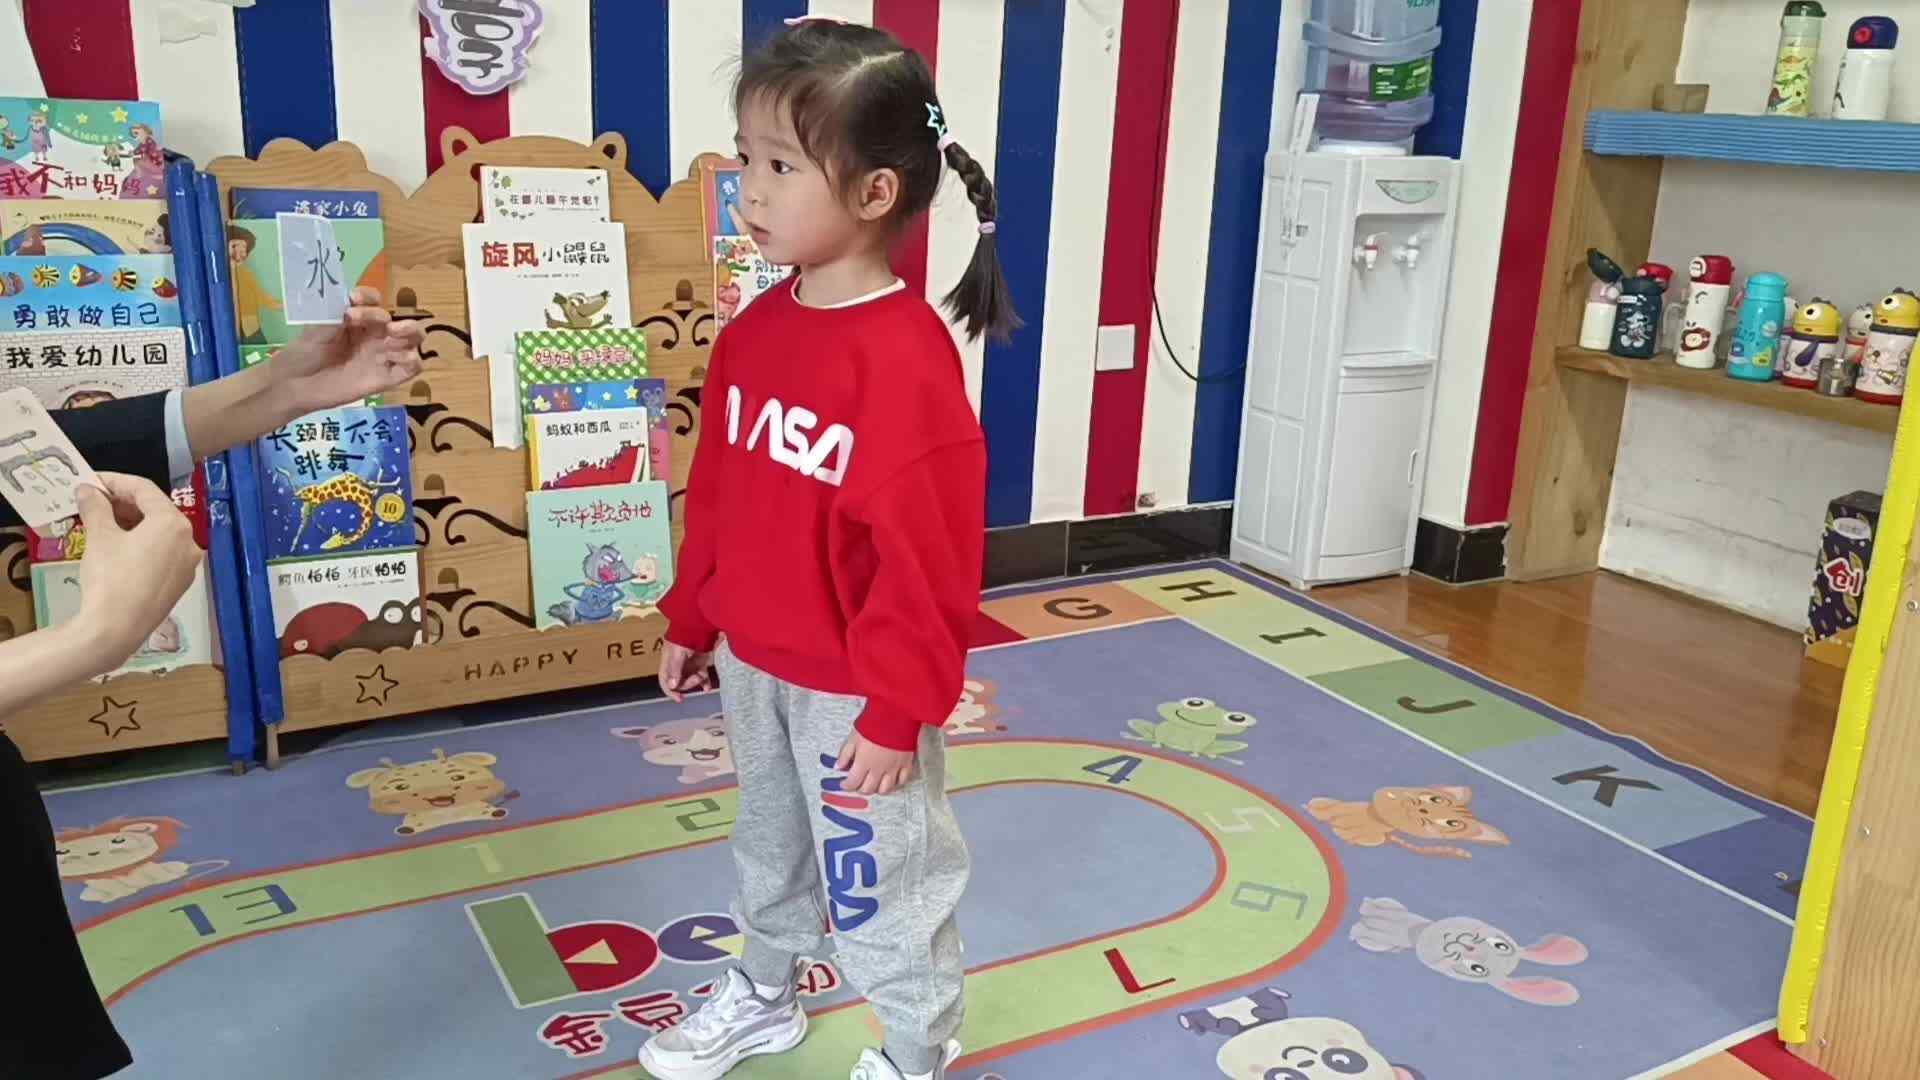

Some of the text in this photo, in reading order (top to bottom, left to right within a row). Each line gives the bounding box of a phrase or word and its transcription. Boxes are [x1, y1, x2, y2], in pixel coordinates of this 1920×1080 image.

[481, 241, 610, 268] 旋风小鼹鼠
[307, 240, 339, 298] 水
[13, 303, 160, 328] 勇敢做自己
[6, 343, 168, 368] 我爱幼儿园
[267, 418, 393, 452] 长颈鹿不会
[546, 421, 612, 436] 蚂蚁和西瓜
[294, 447, 365, 480] 跳舞
[1160, 580, 1237, 602] H
[1043, 597, 1113, 620] G
[1258, 627, 1327, 644] I
[464, 649, 579, 681] HAPPY
[1397, 696, 1477, 715] J
[1082, 755, 1142, 784] 4
[1552, 764, 1664, 808] K
[665, 797, 736, 832] 2
[1206, 806, 1281, 834] 5
[169, 884, 298, 936] 13
